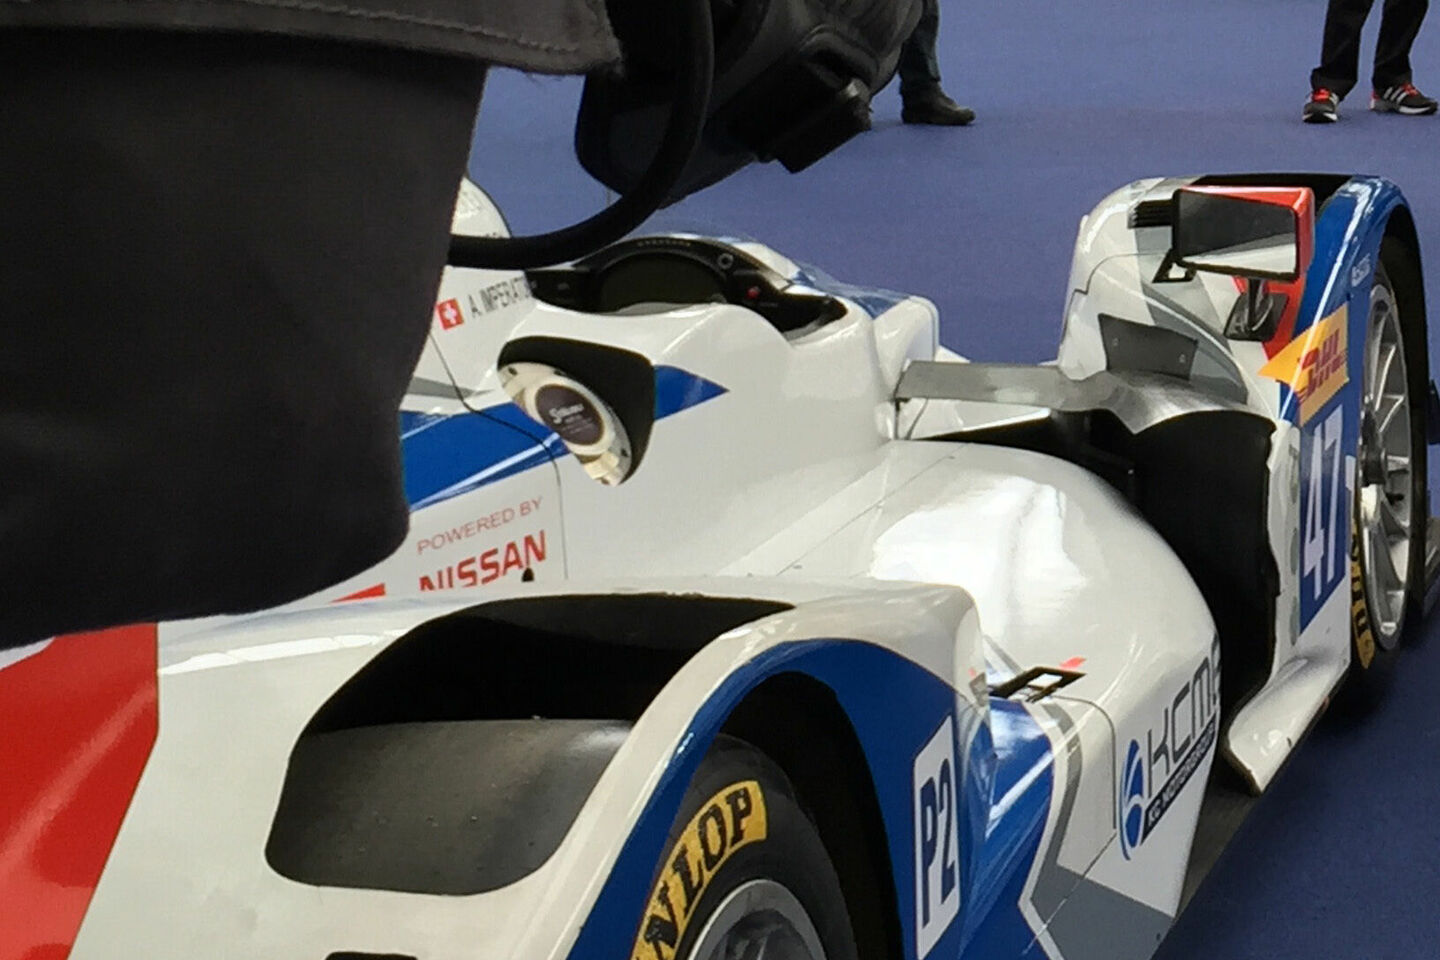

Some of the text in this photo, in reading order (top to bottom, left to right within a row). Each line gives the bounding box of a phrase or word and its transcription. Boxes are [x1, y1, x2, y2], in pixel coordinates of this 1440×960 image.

[416, 496, 543, 556] POWERED BY
[418, 529, 547, 592] NISSAN
[1303, 404, 1343, 601] 47
[920, 757, 957, 930] P2
